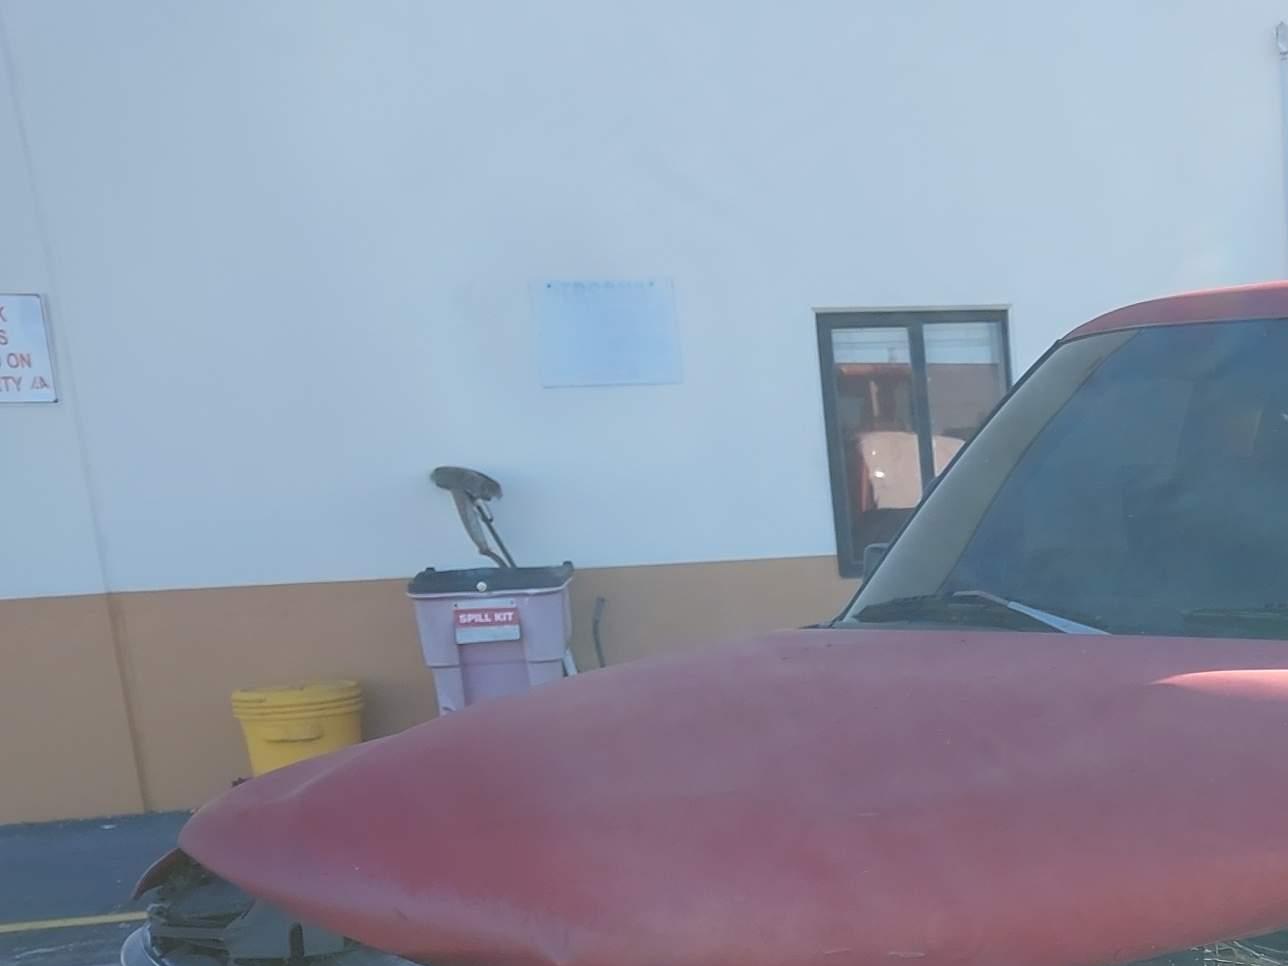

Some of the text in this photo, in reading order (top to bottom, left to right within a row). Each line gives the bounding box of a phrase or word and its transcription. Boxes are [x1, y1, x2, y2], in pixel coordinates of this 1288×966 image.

[7, 353, 31, 368] ON
[459, 612, 514, 624] SPILL KIT
